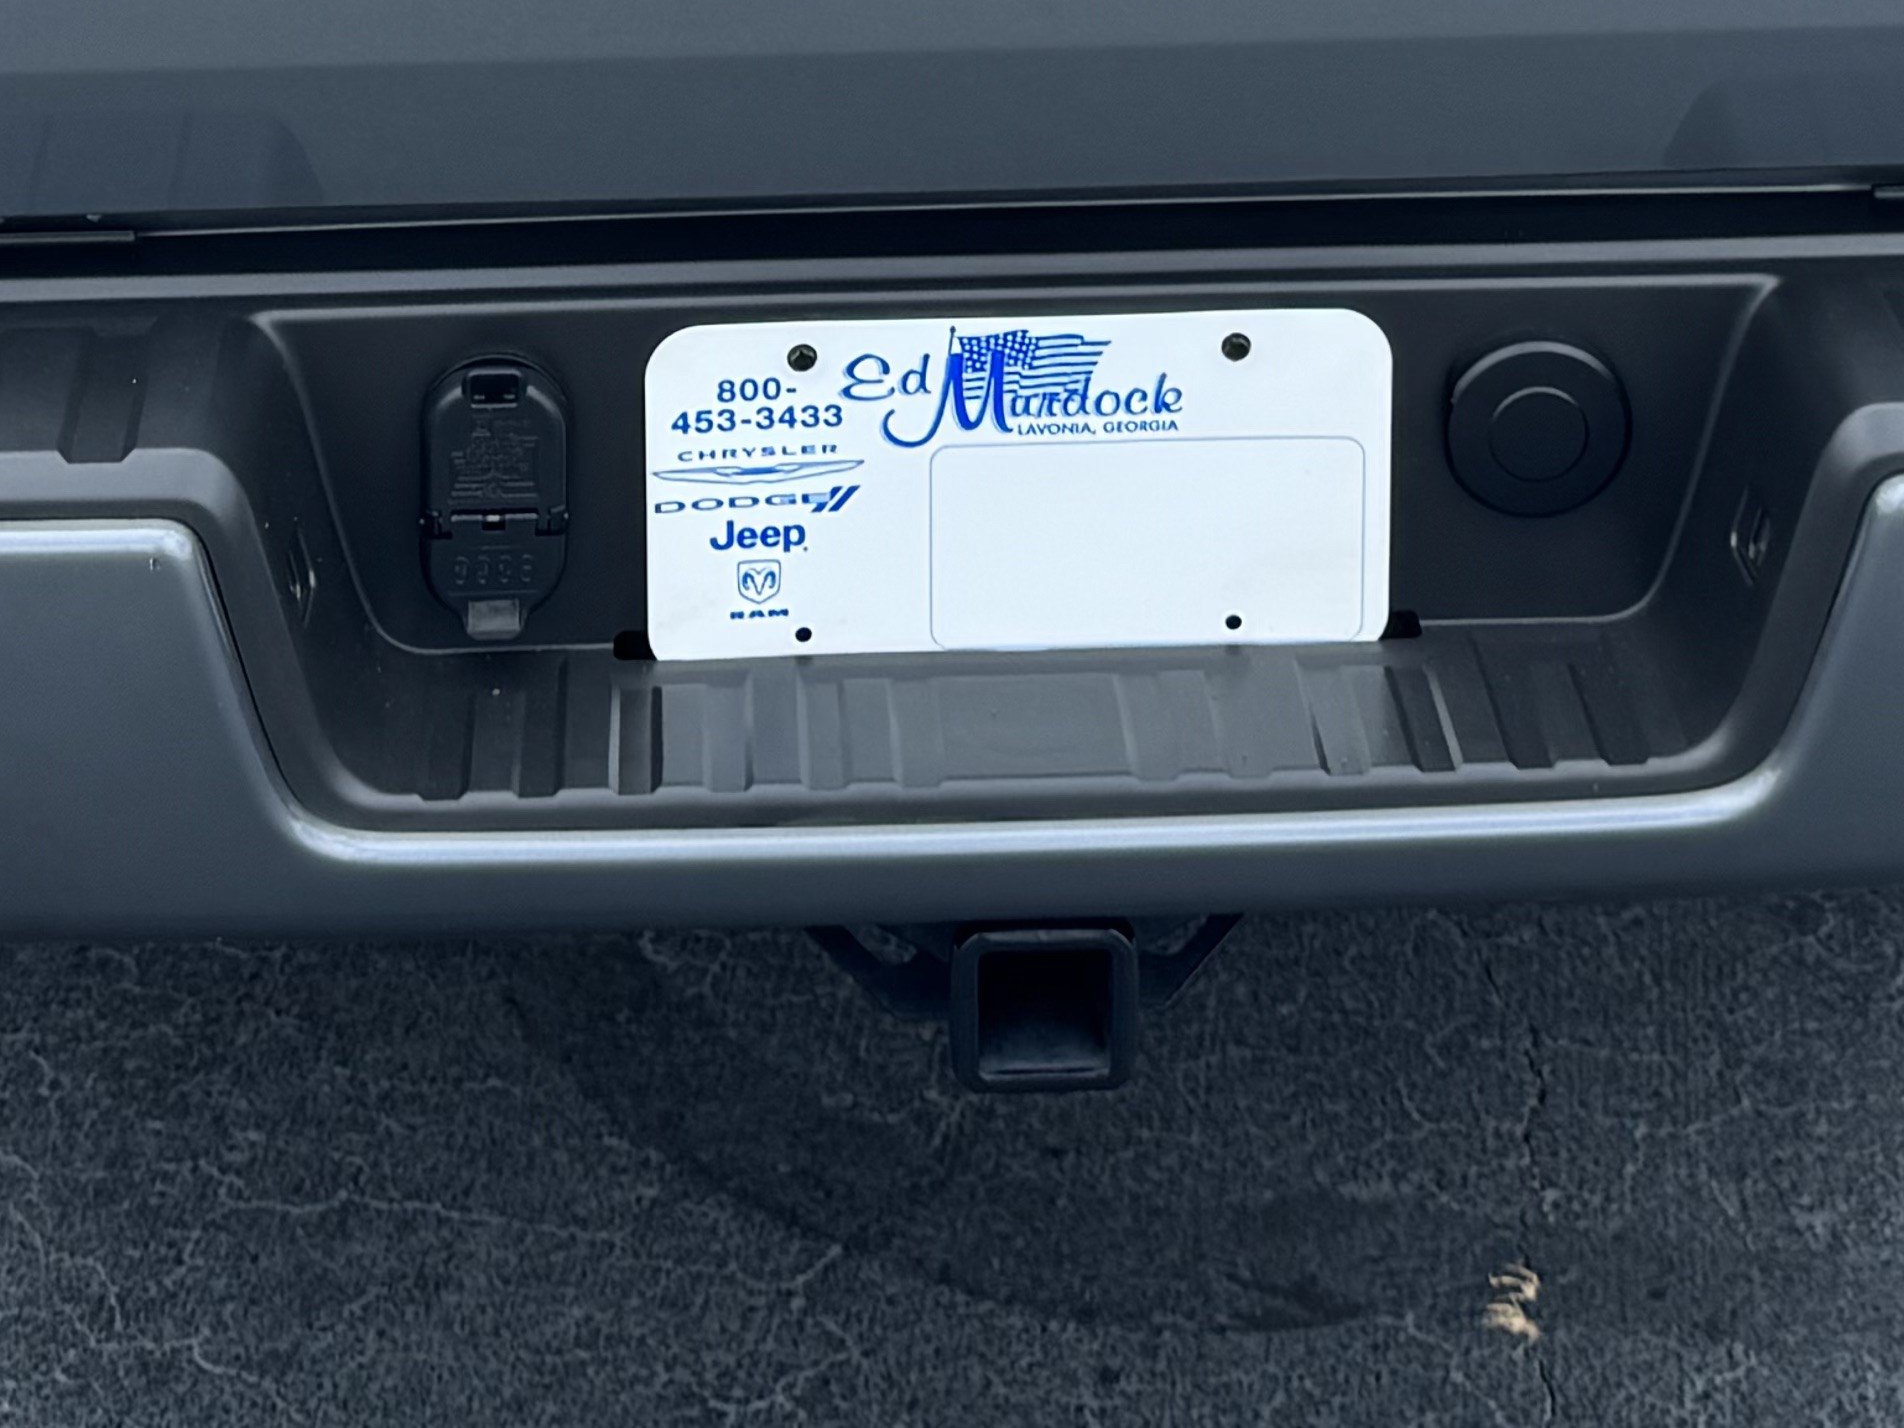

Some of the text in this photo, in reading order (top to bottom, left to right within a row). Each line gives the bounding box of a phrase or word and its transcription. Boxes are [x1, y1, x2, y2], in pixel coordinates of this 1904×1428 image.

[716, 377, 797, 403] 800-
[841, 349, 1183, 448] Ed Murdock
[670, 404, 843, 435] 453-3433
[1017, 419, 1179, 436] LAVONIA, GEORGIA
[677, 444, 838, 462] CHRYSLER
[654, 491, 832, 514] DODGE
[709, 519, 807, 553] Jeep
[729, 608, 790, 620] RAM
